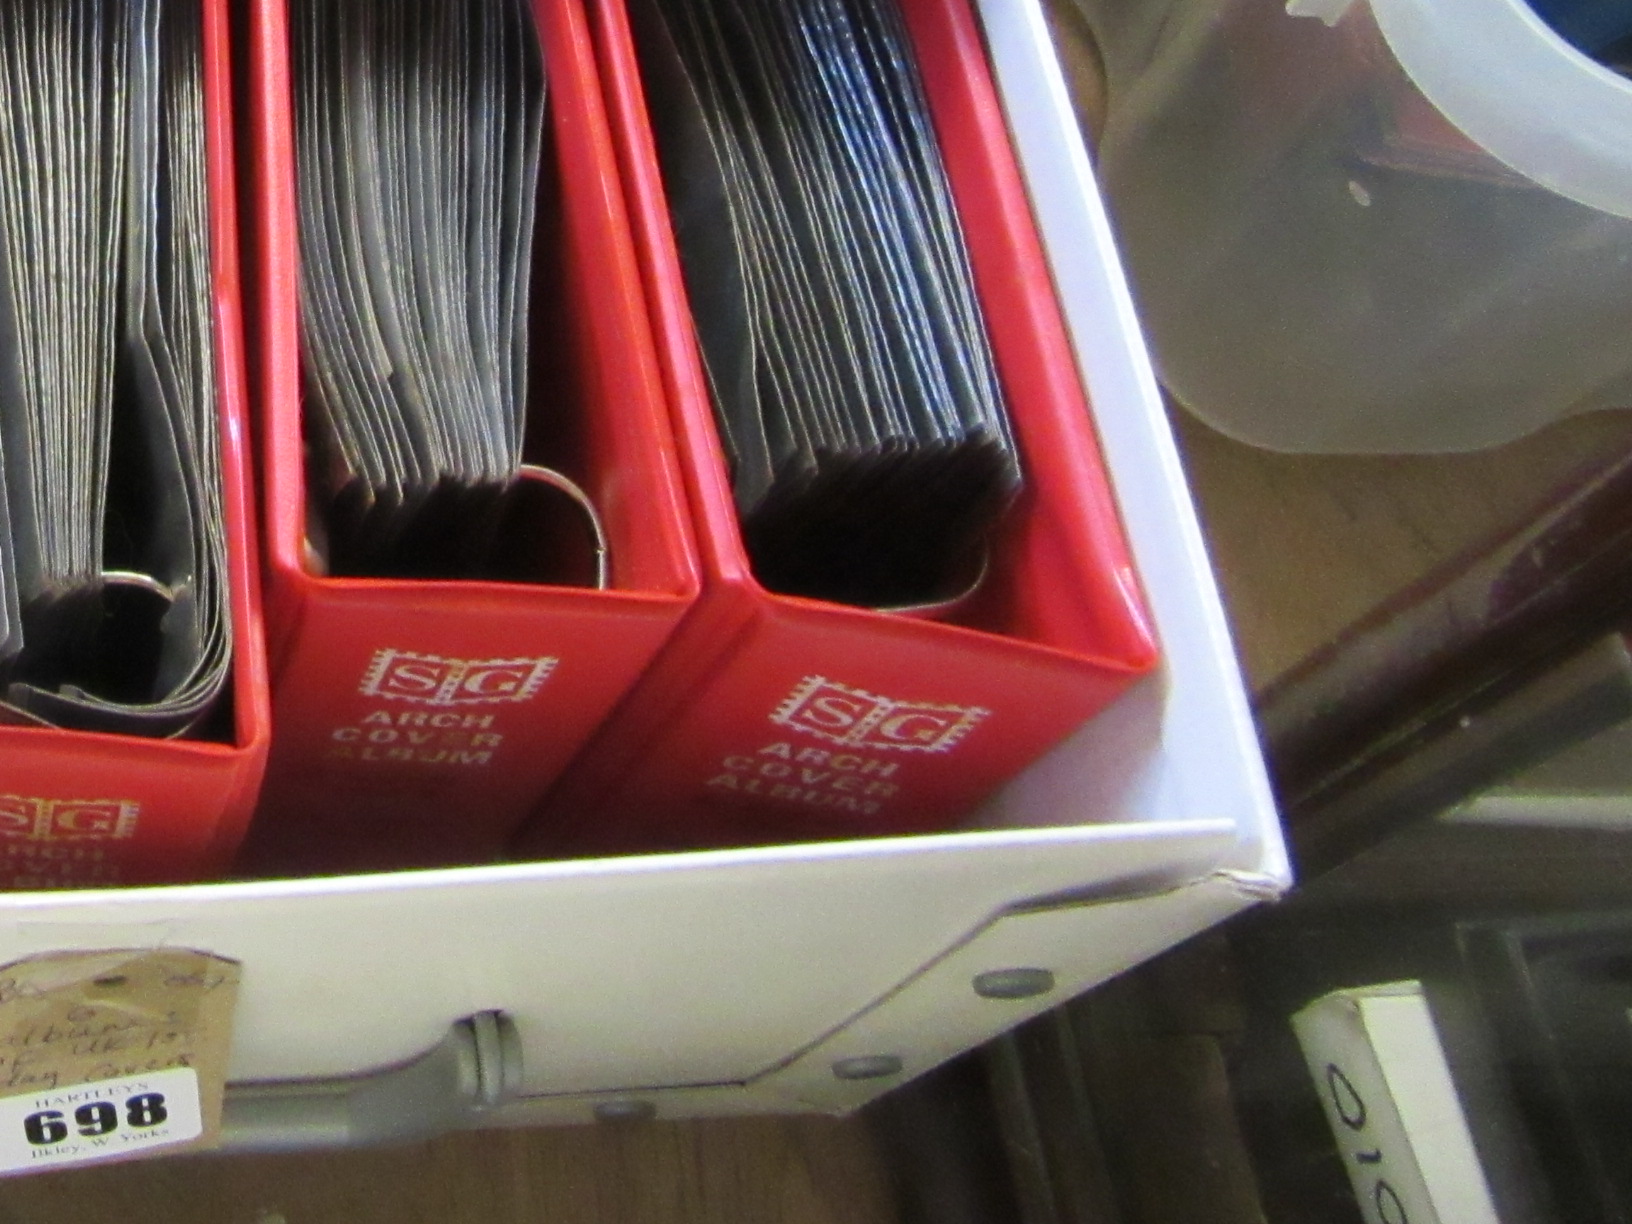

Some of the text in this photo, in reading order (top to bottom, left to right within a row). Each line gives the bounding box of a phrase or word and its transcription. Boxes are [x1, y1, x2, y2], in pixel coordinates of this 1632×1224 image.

[361, 709, 496, 730] ARCH
[722, 755, 901, 797] COVER
[757, 741, 901, 778] ARCH
[34, 1080, 150, 1109] HARTLEYS
[23, 1092, 168, 1146] 698
[120, 1128, 170, 1142] Yorks
